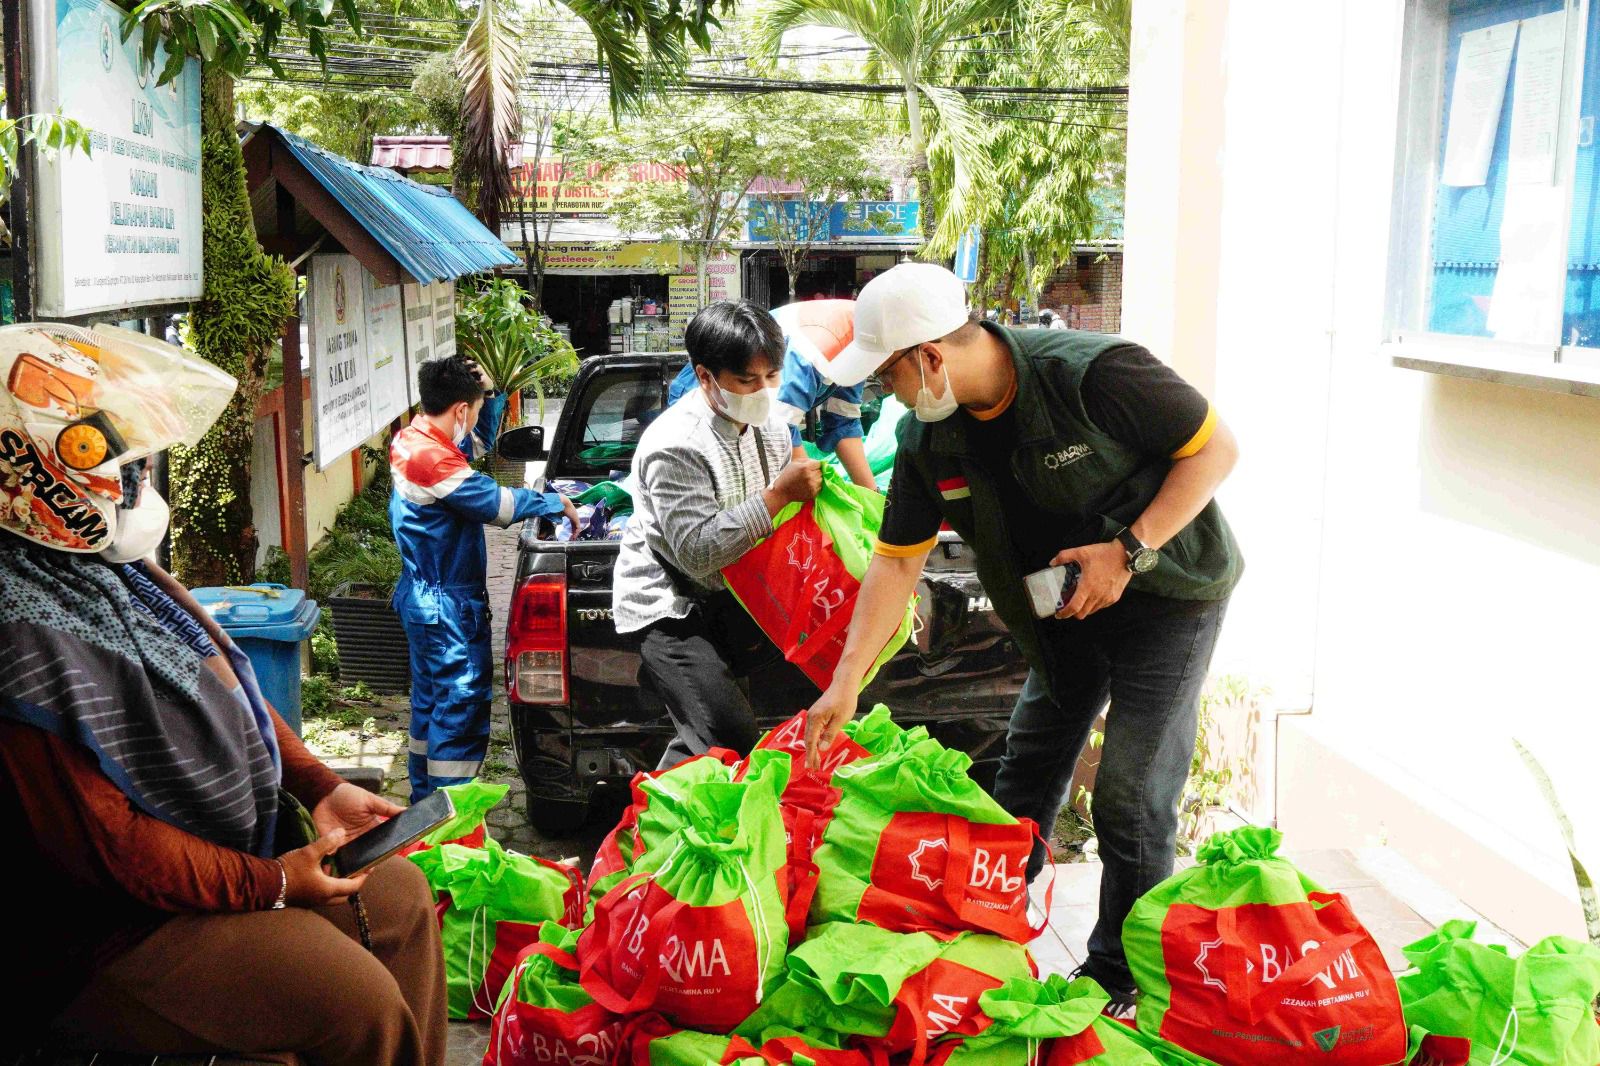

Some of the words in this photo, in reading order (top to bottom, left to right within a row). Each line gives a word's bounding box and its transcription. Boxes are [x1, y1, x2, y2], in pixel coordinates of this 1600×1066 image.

[556, 201, 591, 209] PERABOTAN
[0, 430, 109, 546] STREAM
[1317, 992, 1355, 1007] PERTAMINA
[1355, 990, 1366, 999] RU
